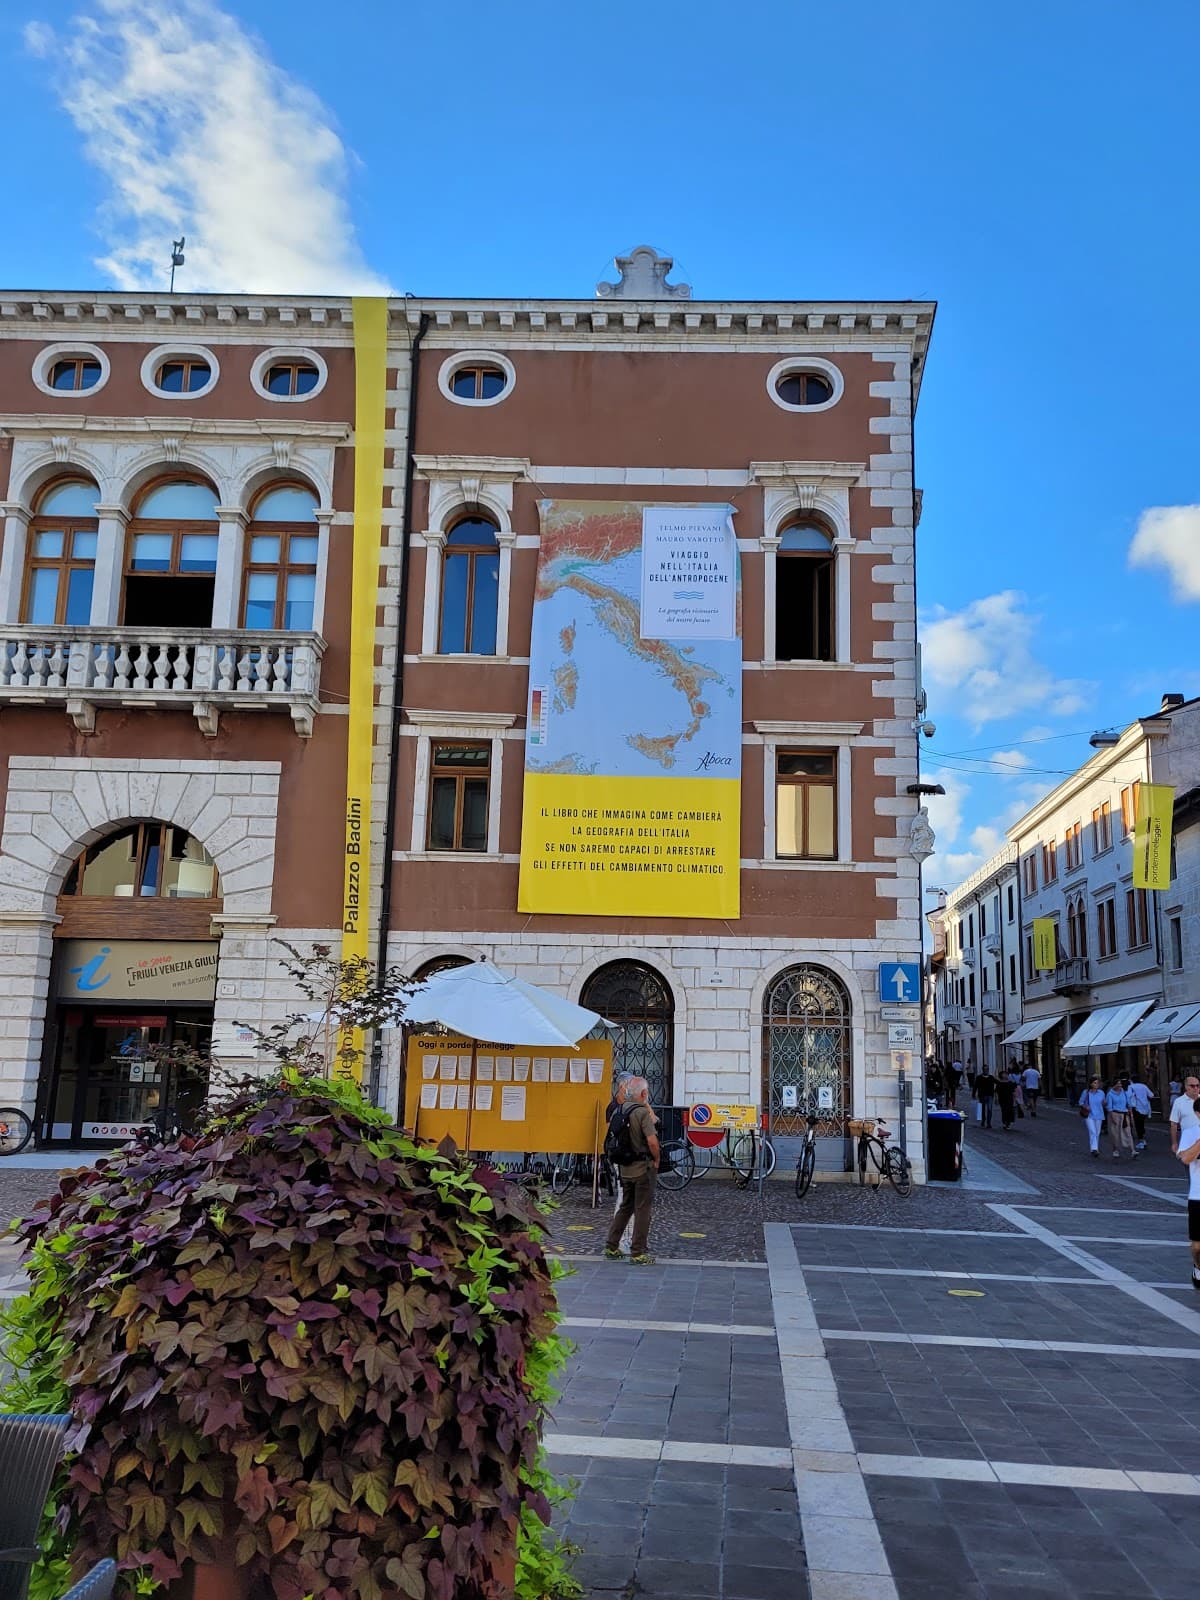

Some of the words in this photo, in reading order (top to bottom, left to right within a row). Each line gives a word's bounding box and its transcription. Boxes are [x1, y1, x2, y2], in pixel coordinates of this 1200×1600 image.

[671, 551, 709, 559] VIAGGIO
[661, 562, 718, 571] NELL'ITALIA
[649, 574, 728, 583] DELL'ANTROPOCENE
[694, 752, 733, 772] Aboca
[541, 808, 549, 817] IL
[553, 808, 578, 818] LIBRO
[582, 809, 598, 818] CHE
[602, 810, 646, 820] IMMAGINA
[650, 811, 673, 820] COME
[678, 810, 722, 822] CAMBIERÀ
[346, 797, 361, 855] Badini
[572, 827, 582, 835] LA
[586, 827, 634, 837] GEOGRAFIA
[638, 828, 690, 838] DELL'ITALIA
[545, 843, 555, 852] SE
[560, 844, 577, 853] NON
[580, 844, 616, 854] SAREMO
[619, 845, 650, 855] CAPACI
[654, 846, 662, 855] DI
[666, 846, 716, 856] ARRESTARE
[1151, 817, 1162, 883] pordenonelegge.it
[533, 861, 547, 870] GLI
[551, 861, 586, 871] EFFETTI
[590, 862, 605, 871] DEL
[610, 863, 673, 873] CAMBIAMENTO
[344, 861, 360, 934] Palazzo
[132, 967, 158, 981] FRIULI
[159, 960, 193, 975] VENEZIA
[194, 955, 217, 968] GIULI
[417, 1040, 437, 1049] Oggi
[447, 1041, 515, 1050] pordeonelegge
